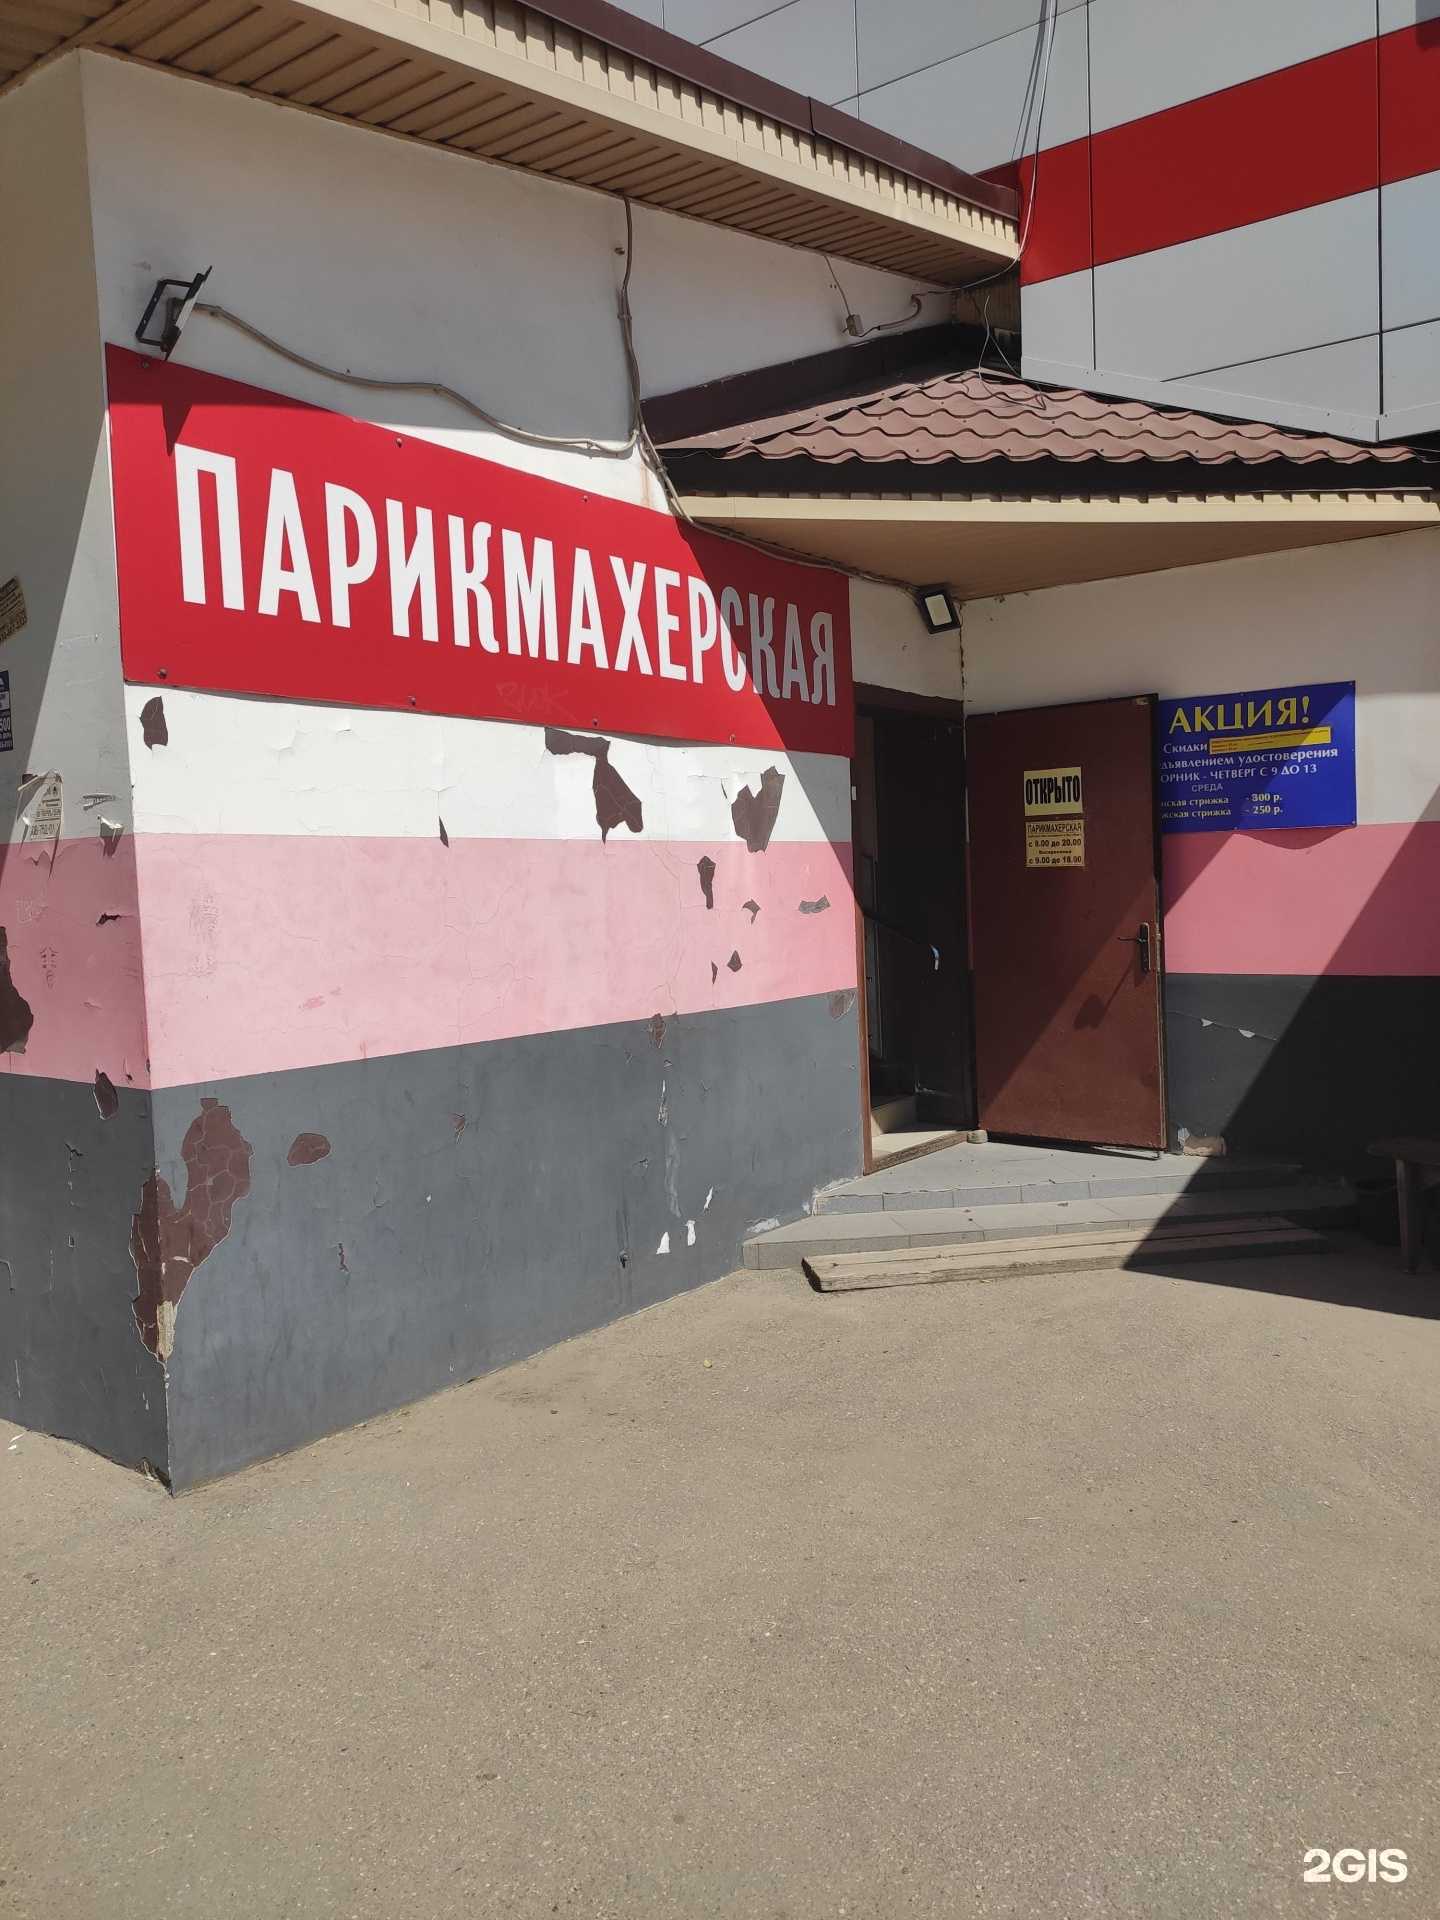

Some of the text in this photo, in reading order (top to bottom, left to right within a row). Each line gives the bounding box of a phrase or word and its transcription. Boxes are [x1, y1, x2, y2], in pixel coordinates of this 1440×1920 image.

[175, 443, 836, 706] ПАРИКМАХЕРСКАЯ
[1169, 696, 1310, 734] АКЦИЯ!
[1163, 743, 1208, 754] Скидки
[1239, 748, 1338, 767] удостоверения
[1210, 767, 1257, 780] ЧЕТВЕРГ
[1260, 767, 1268, 776] С
[1271, 767, 1278, 776] 9
[1281, 765, 1300, 775] ДО
[1303, 764, 1318, 773] 13
[1025, 775, 1081, 805] ОТКРЫТО
[1191, 783, 1223, 793] СРЕДА
[1189, 797, 1229, 807] стрижка
[1191, 809, 1231, 819] стрижка
[1252, 805, 1271, 815] 250
[1027, 823, 1081, 833] ПАРИКМАХЕРСКАЯ
